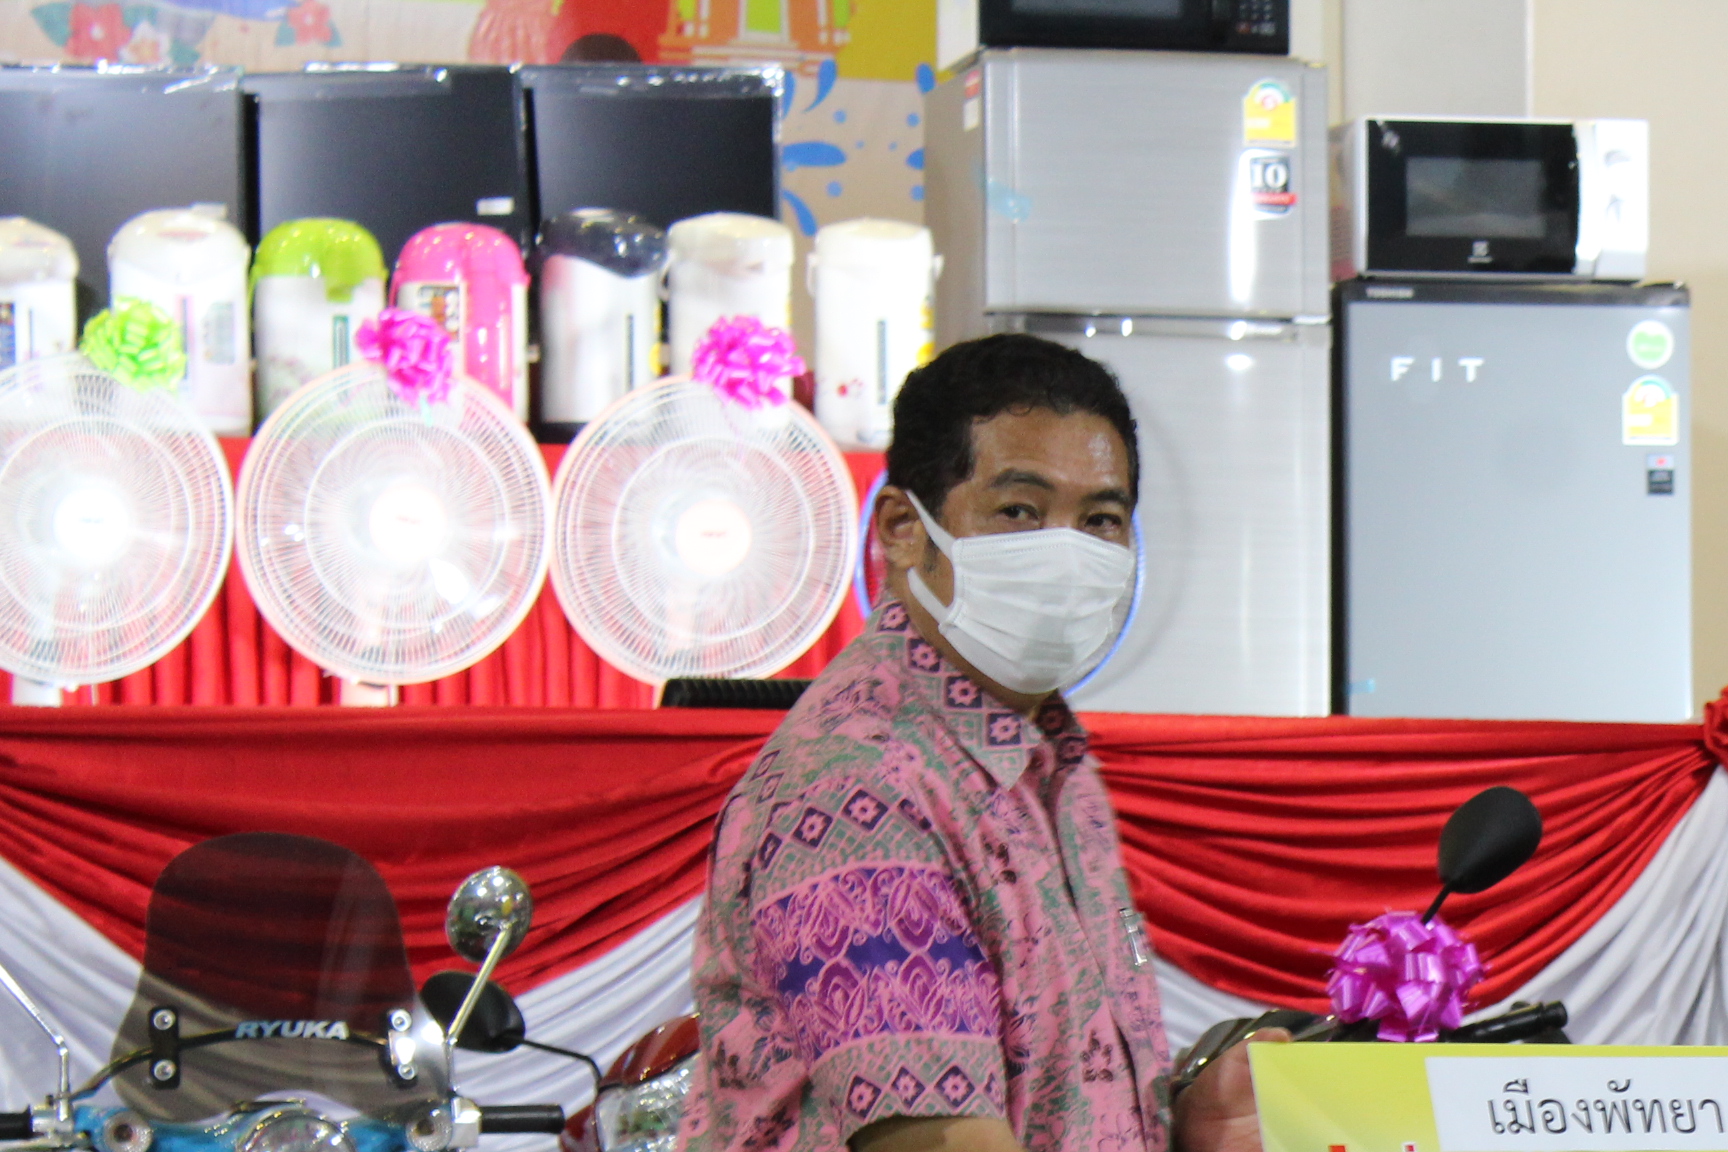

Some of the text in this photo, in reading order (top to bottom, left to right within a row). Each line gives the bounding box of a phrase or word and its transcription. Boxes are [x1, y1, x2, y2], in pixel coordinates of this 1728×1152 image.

[1250, 162, 1287, 189] 10
[1389, 355, 1486, 383] FIT
[234, 1020, 350, 1040] RYUKA
[1487, 1077, 1726, 1135] เมืองพัทยา
